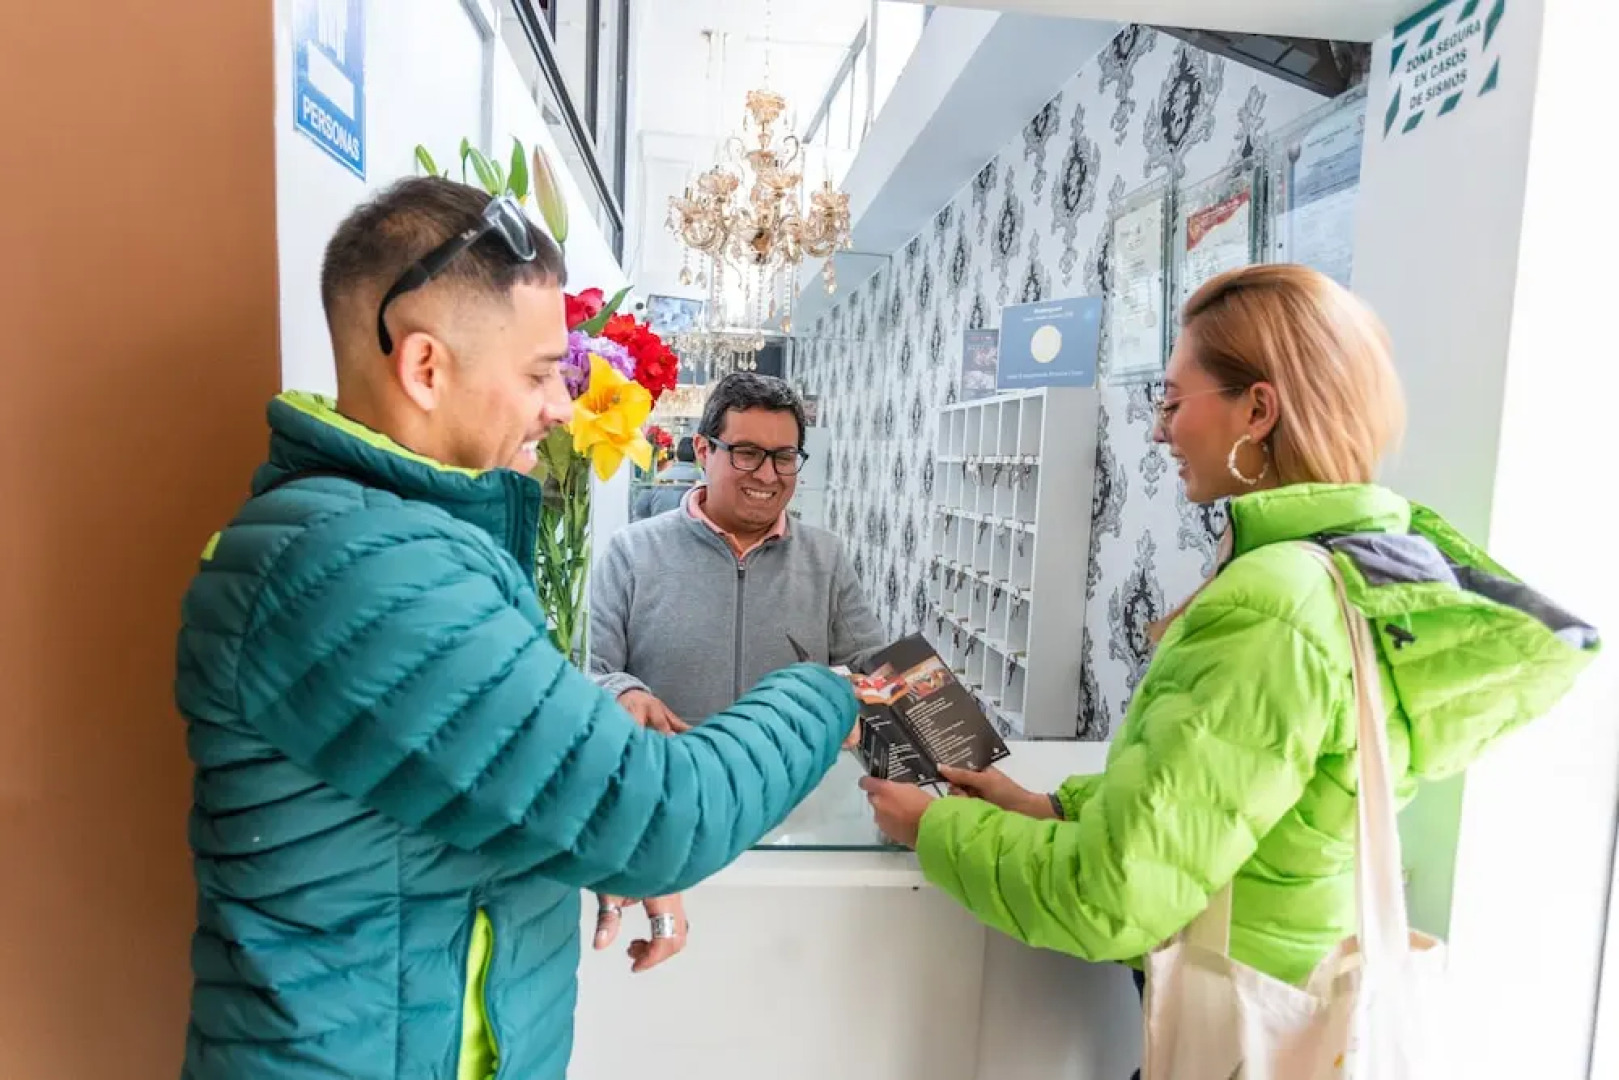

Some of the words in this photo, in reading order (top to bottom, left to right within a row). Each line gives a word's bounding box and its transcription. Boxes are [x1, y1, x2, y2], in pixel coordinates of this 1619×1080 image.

[1406, 47, 1433, 73] ZONA
[1436, 19, 1481, 55] SEGURA
[1414, 71, 1427, 87] EN
[1430, 48, 1467, 79] CASOS
[1410, 92, 1423, 110] DE
[1426, 68, 1467, 102] SISMOS
[303, 93, 360, 161] PERSONAS
